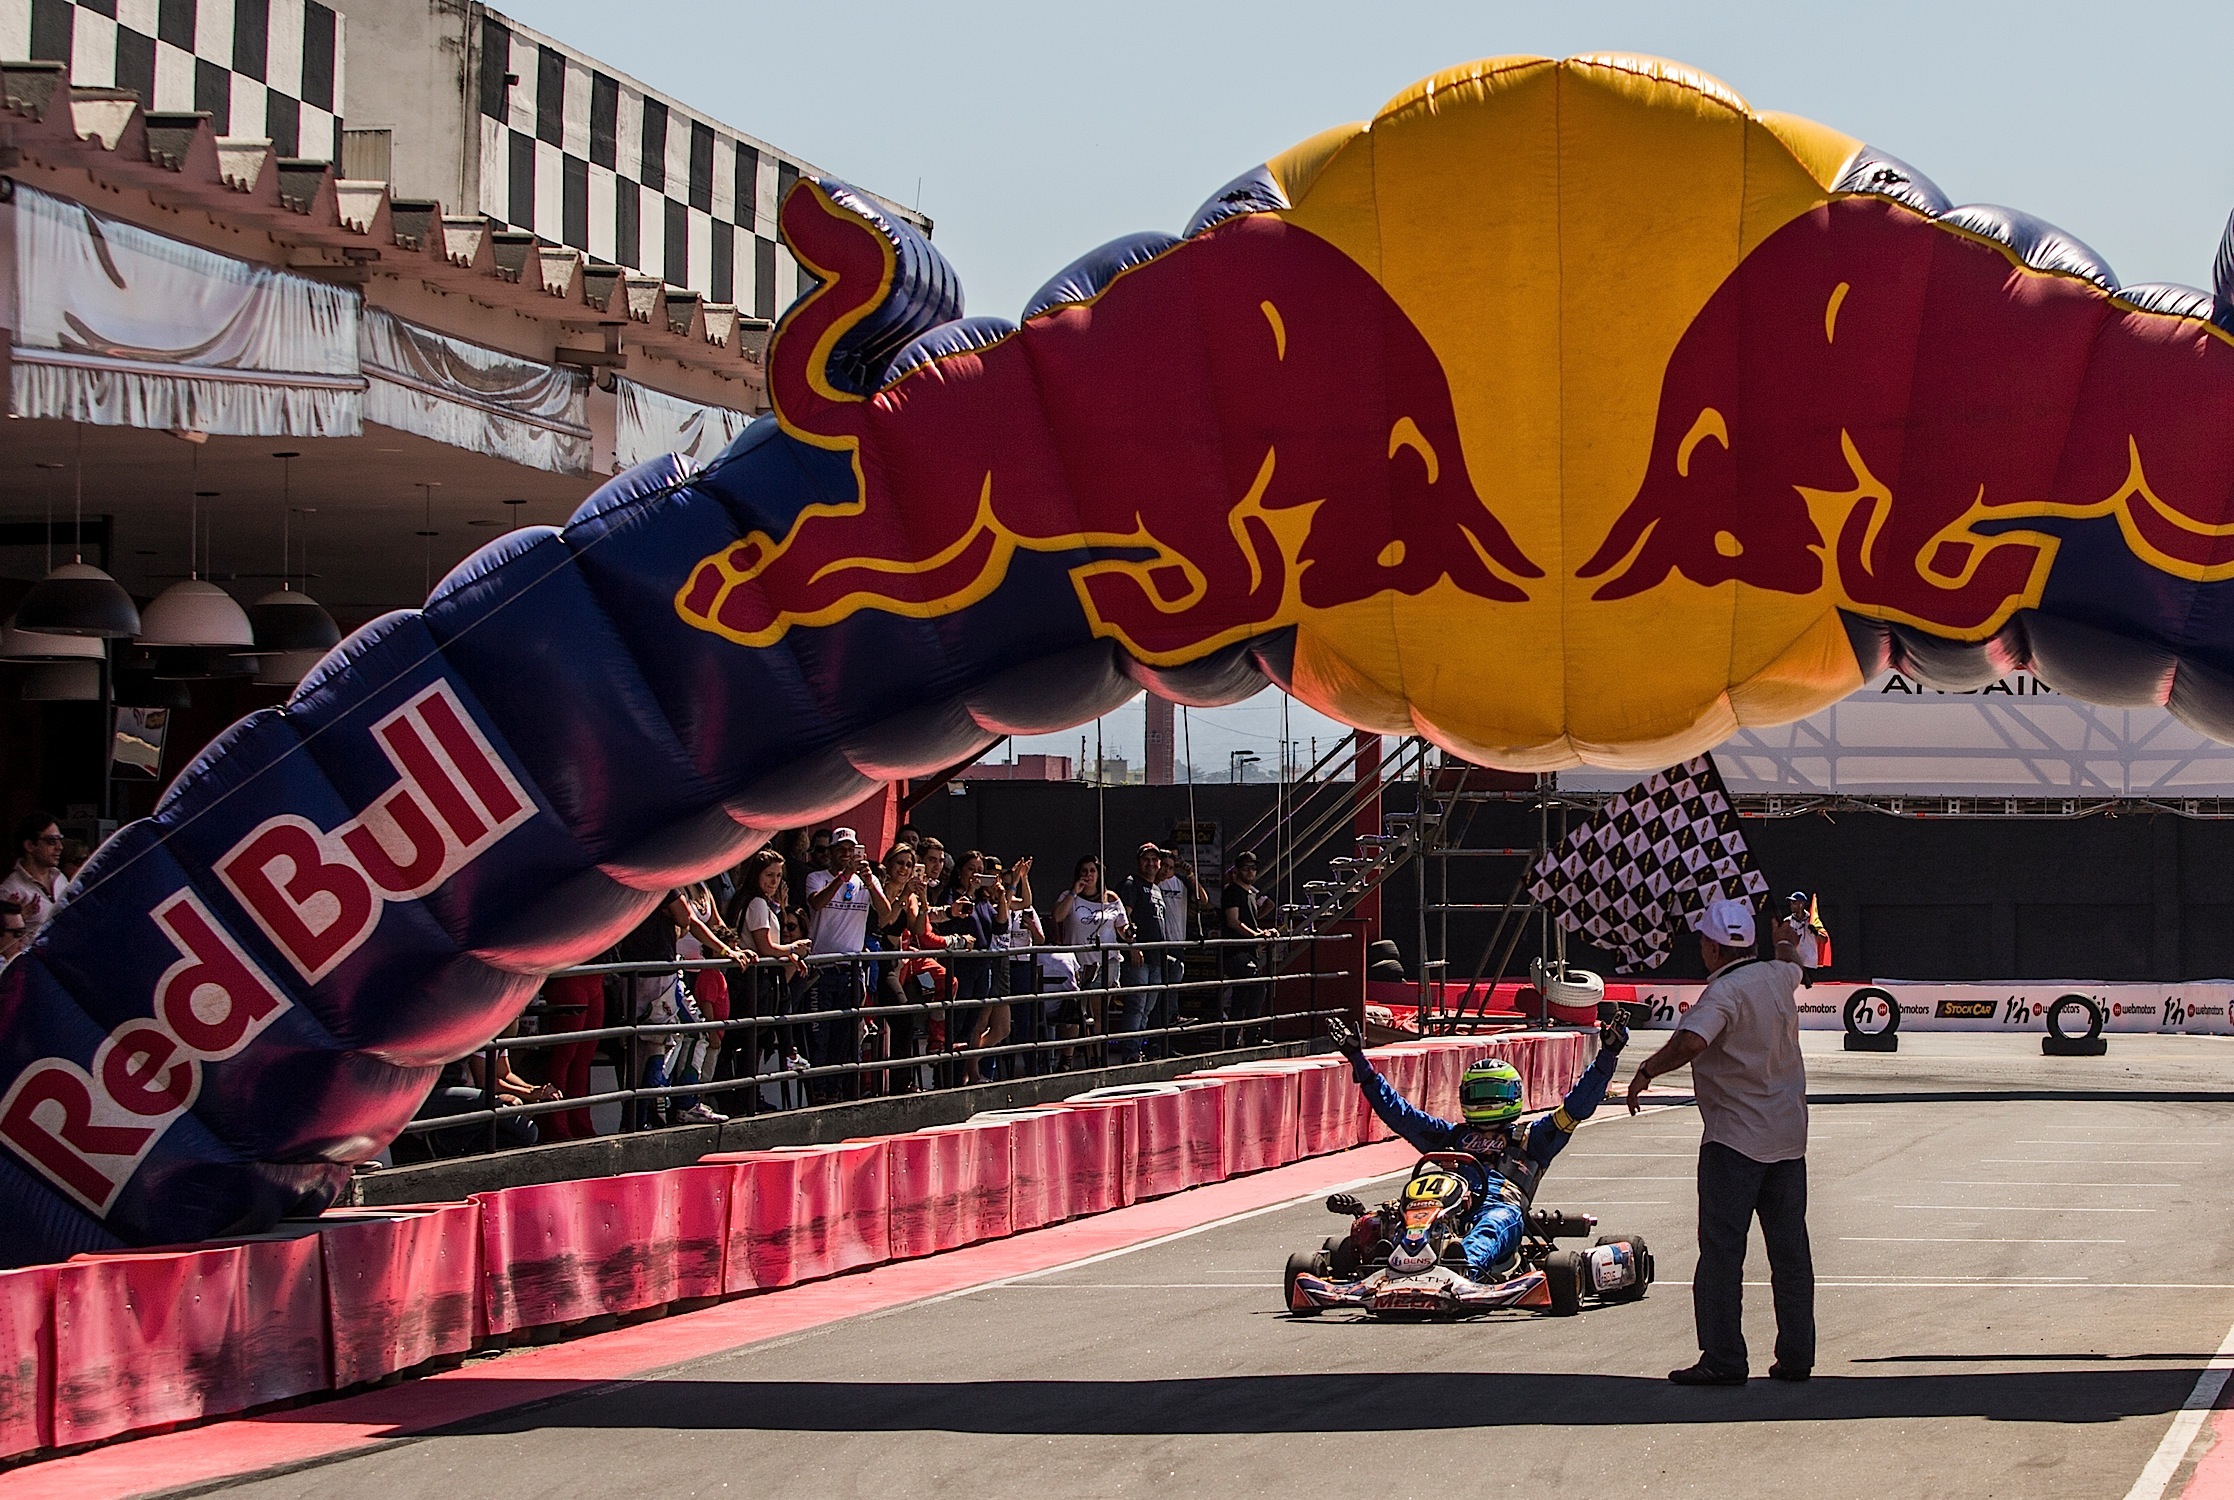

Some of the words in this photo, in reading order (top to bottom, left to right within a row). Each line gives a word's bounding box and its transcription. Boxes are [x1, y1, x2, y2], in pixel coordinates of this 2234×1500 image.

[1, 892, 290, 1214] Red
[215, 680, 536, 982] Bull
[2122, 1003, 2156, 1015] webmotors
[2195, 1005, 2224, 1016] webmotors
[1416, 1178, 1445, 1196] 14
